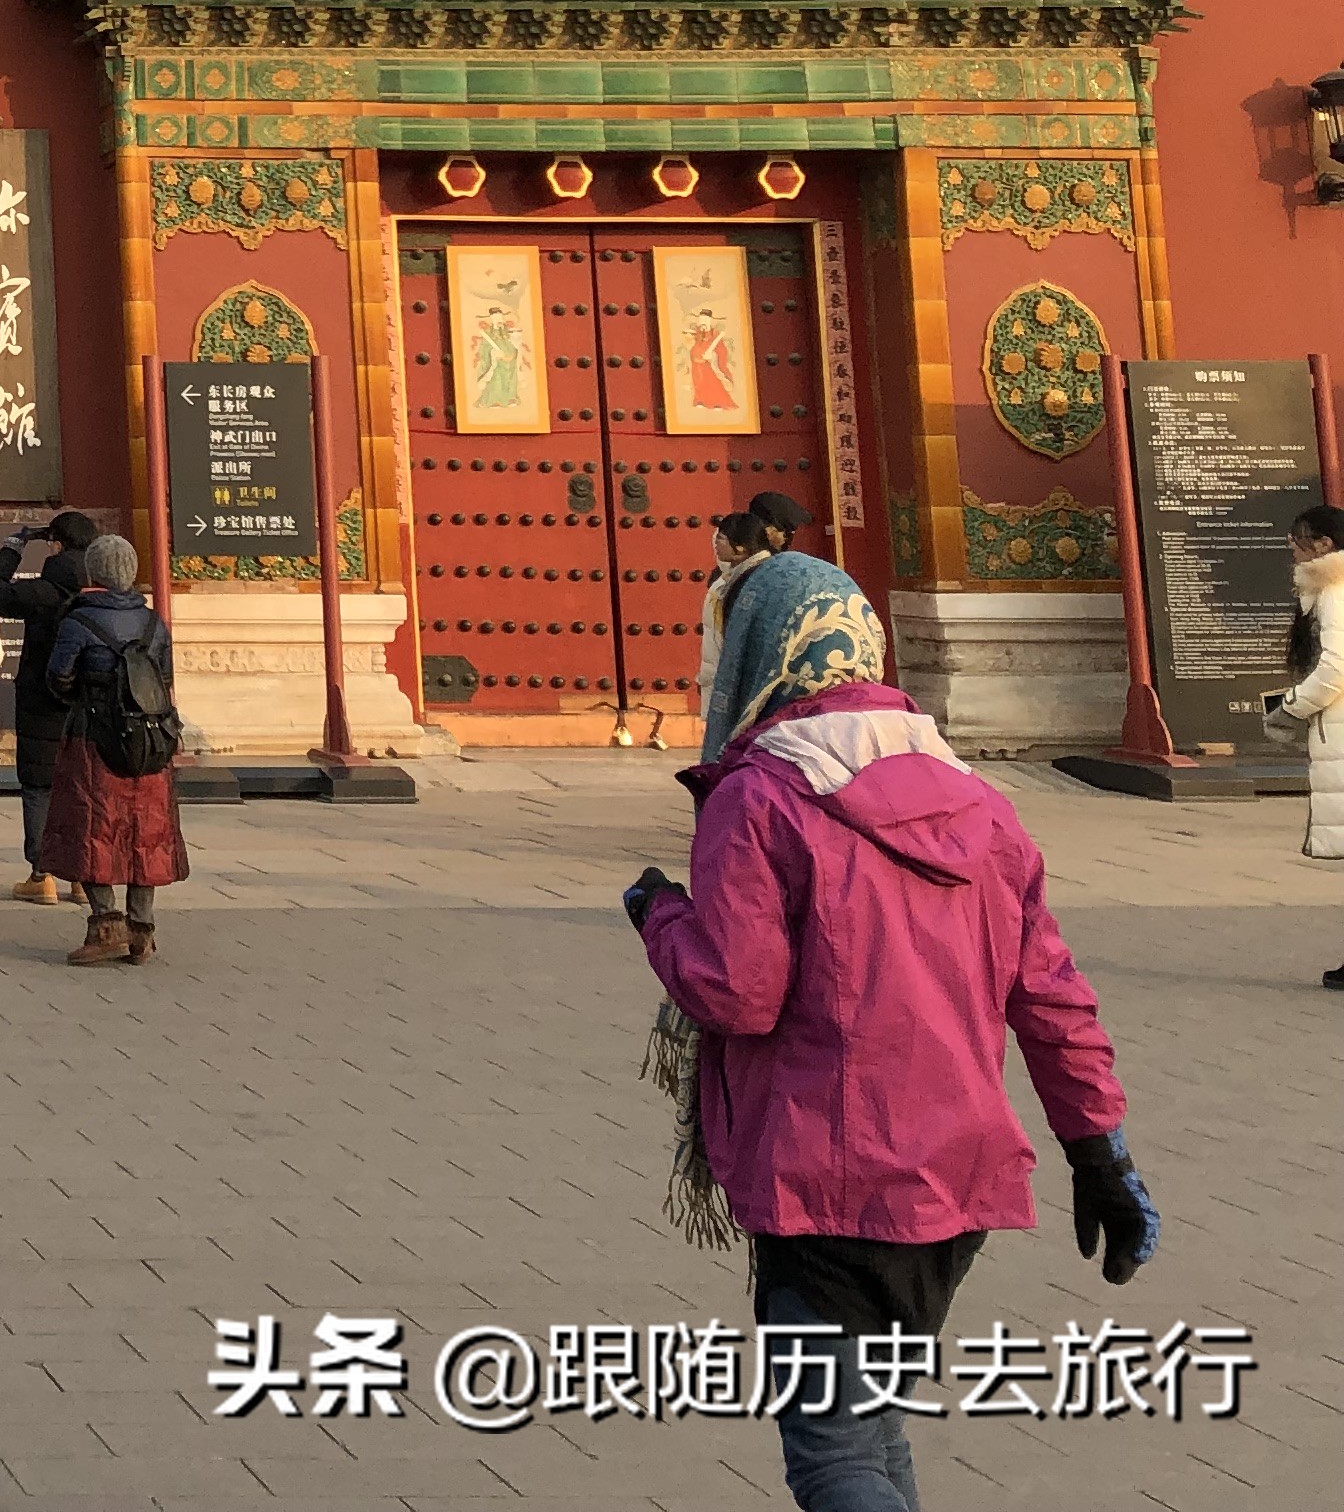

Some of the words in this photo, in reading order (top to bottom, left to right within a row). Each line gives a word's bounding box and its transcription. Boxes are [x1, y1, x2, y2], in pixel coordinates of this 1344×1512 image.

[1195, 370, 1246, 382] 购票须知
[209, 384, 276, 398] 东长房观众
[208, 400, 249, 412] 服务区
[210, 430, 276, 443] 神武门出口
[211, 461, 251, 474] 派出所
[237, 486, 276, 499] 卫生间
[213, 515, 296, 528] 珍宝馆售票处
